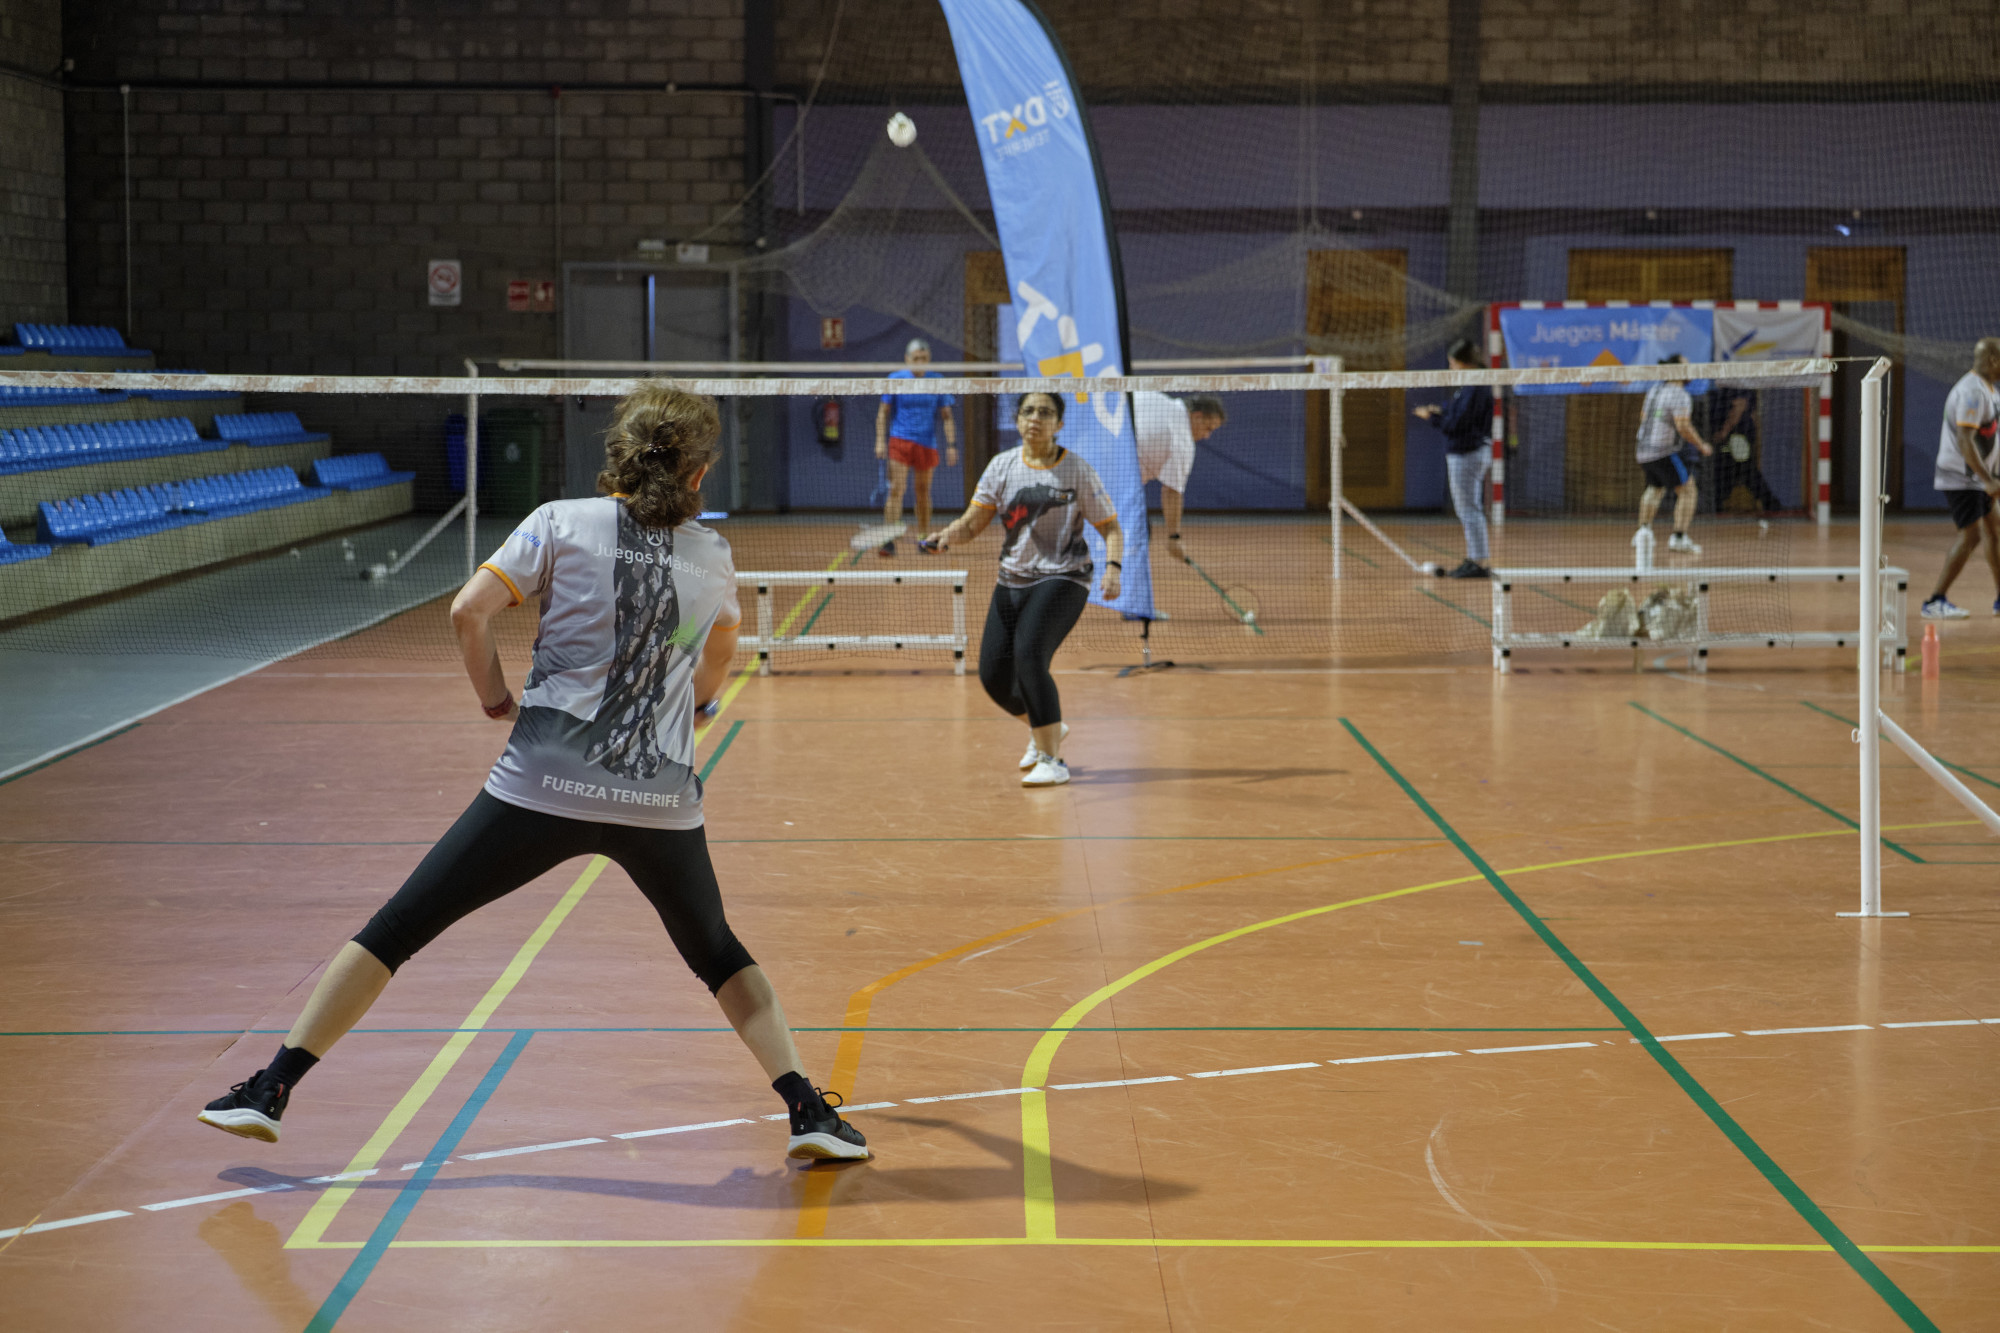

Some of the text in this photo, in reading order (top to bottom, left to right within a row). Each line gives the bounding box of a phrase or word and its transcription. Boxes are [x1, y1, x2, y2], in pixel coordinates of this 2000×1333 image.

[1530, 319, 1681, 346] Juegos Máster
[521, 530, 542, 548] vida
[593, 543, 709, 580] Juegos Máster
[541, 774, 680, 808] FUERZA TENERIFE
